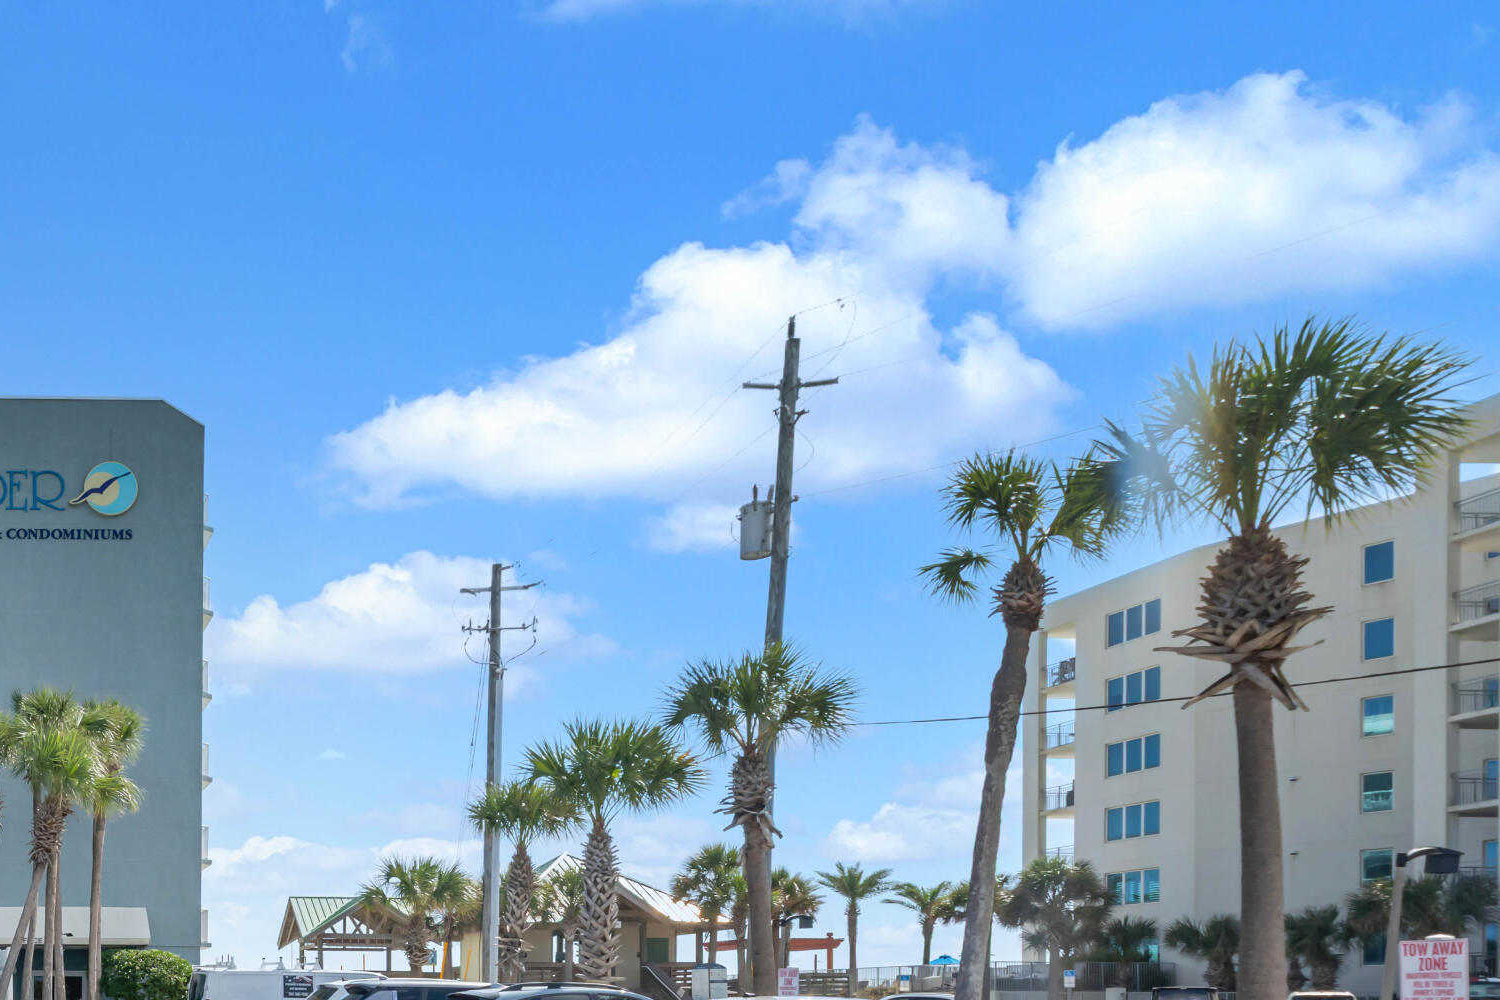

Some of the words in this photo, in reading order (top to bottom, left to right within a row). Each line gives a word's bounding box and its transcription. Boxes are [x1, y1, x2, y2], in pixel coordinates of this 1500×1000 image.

[6, 528, 133, 541] CONDOMINIUMS
[1402, 943, 1428, 956] TOW
[1432, 942, 1464, 955] AWAY
[1418, 957, 1448, 971] ZONE
